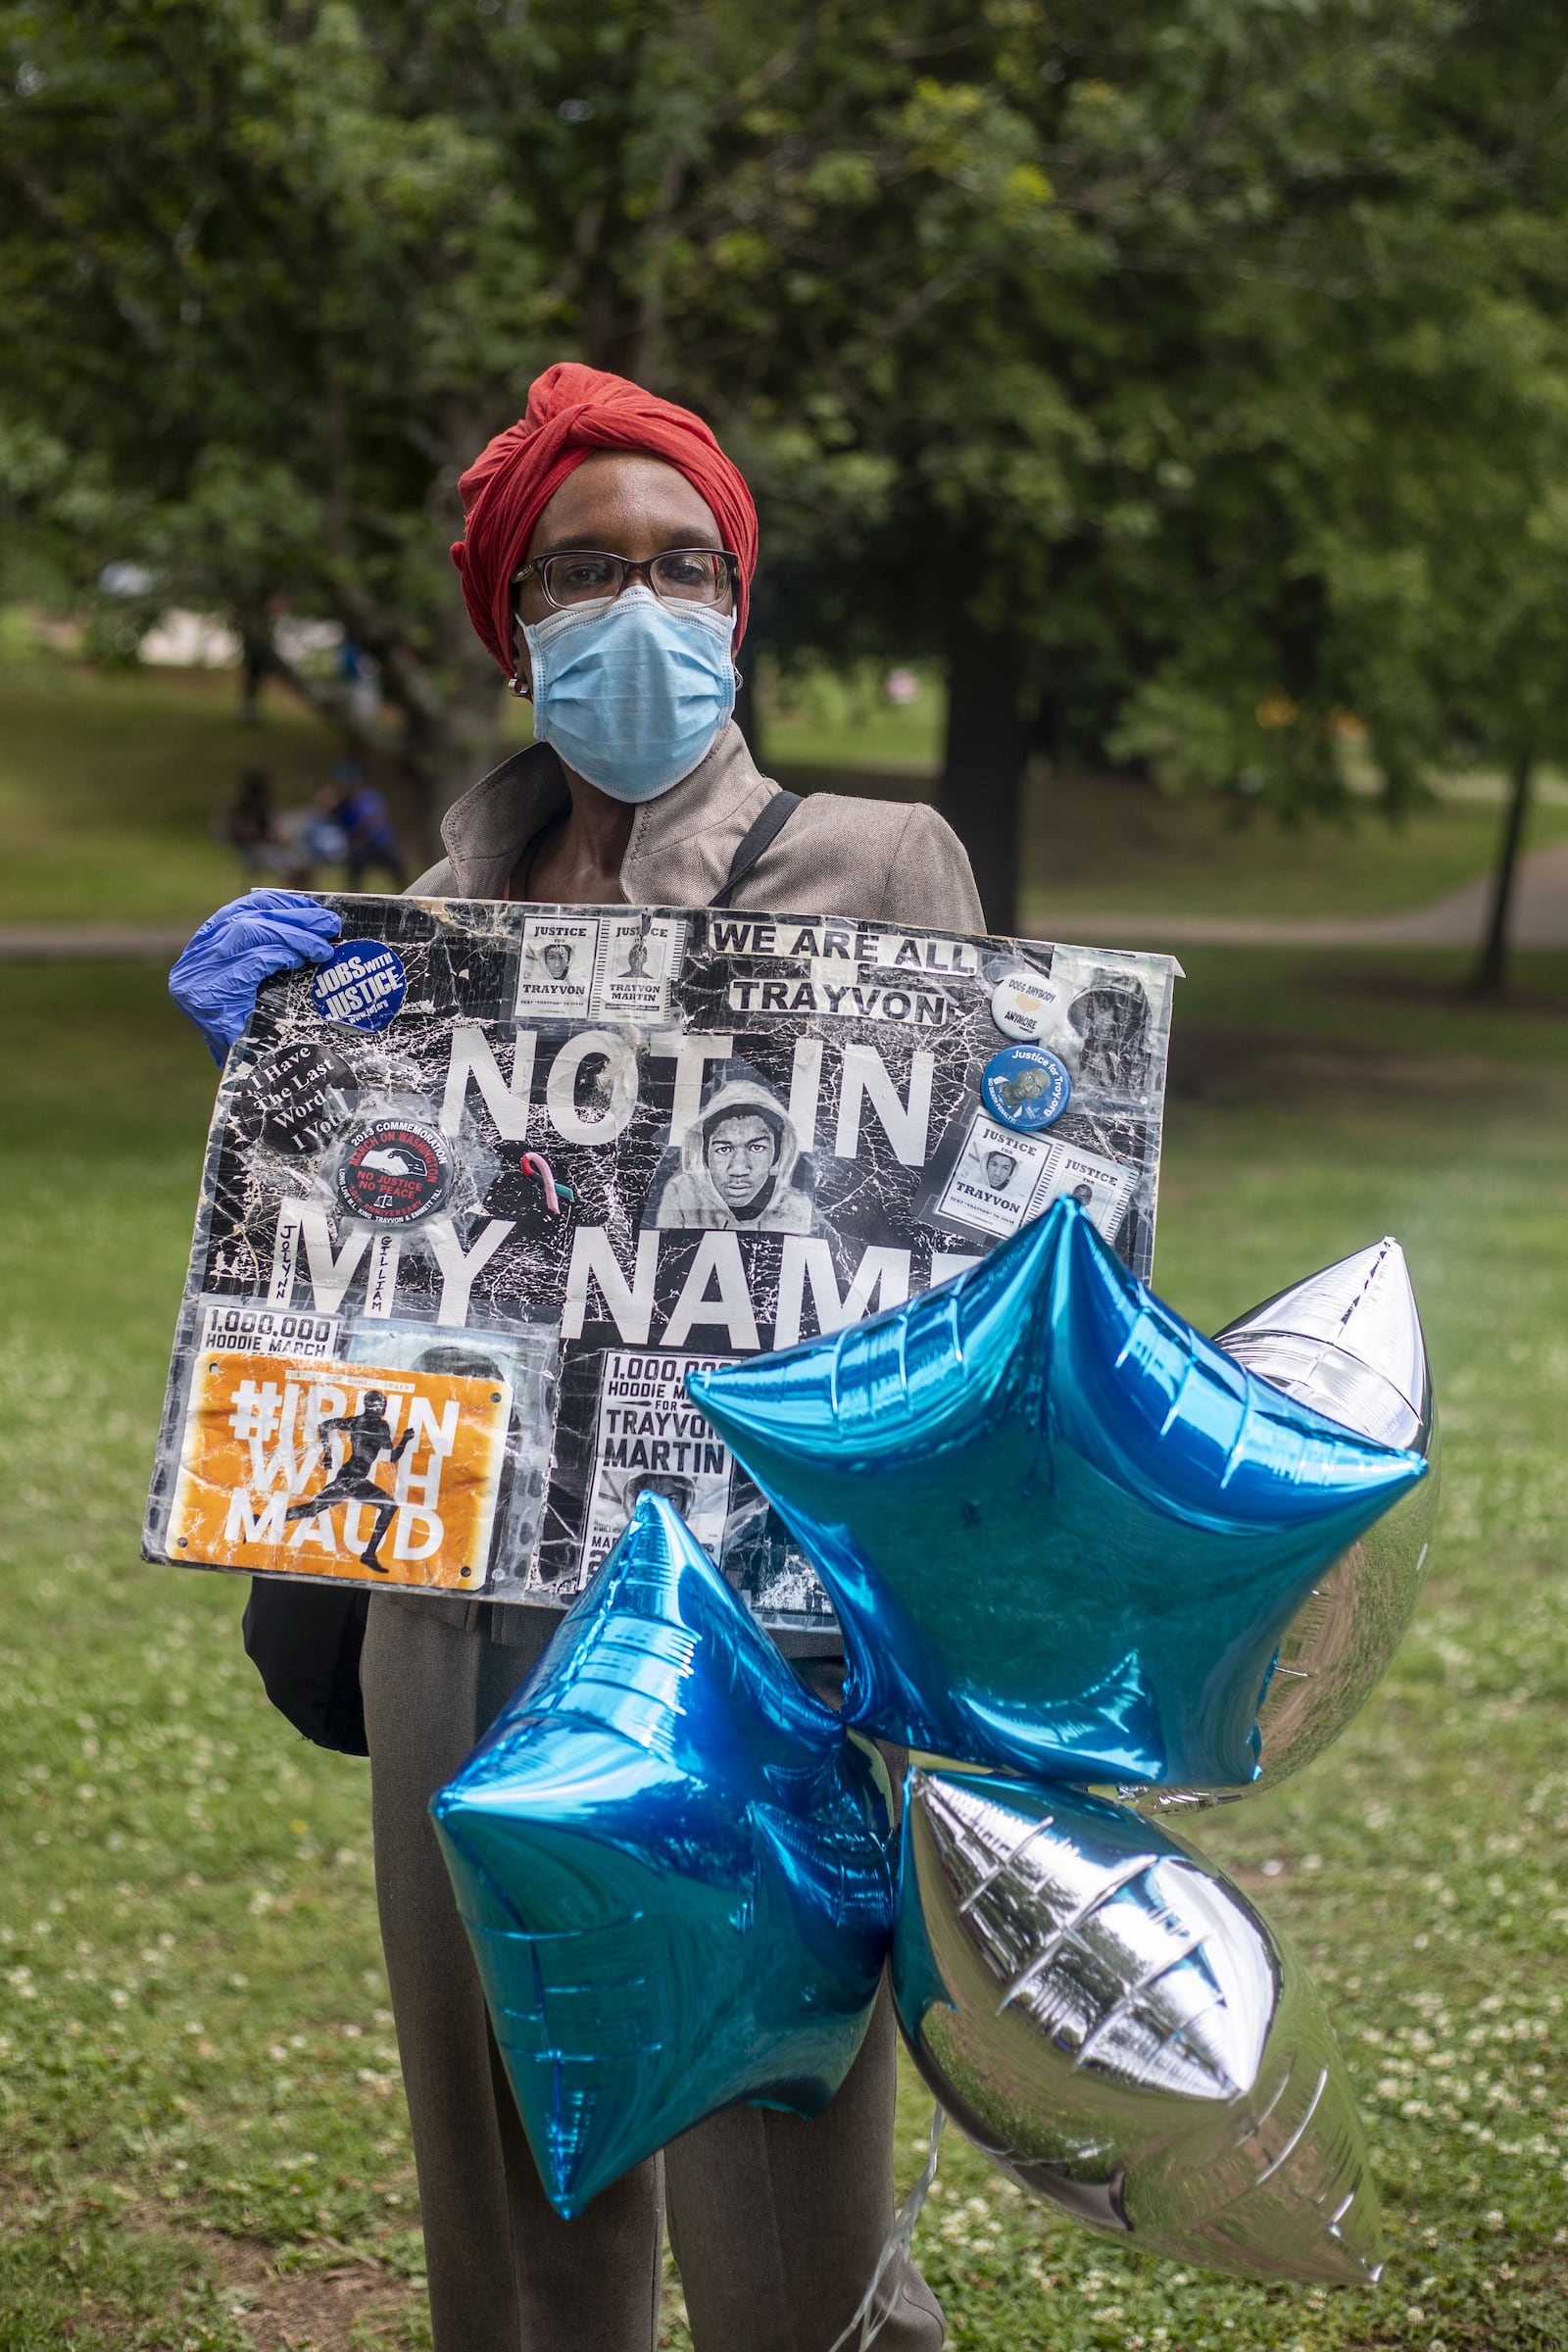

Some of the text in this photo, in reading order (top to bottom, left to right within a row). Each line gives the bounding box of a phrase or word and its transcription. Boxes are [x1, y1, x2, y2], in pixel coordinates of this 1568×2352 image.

[534, 926, 587, 937] JUSTICE
[615, 927, 668, 938] JUSCE
[713, 922, 975, 973] WE ARE ALL
[315, 953, 393, 998] JOBS WITH
[610, 984, 661, 993] TRAYVON
[325, 965, 403, 1020] JUSTICE
[522, 984, 586, 996] TRAYVON
[612, 993, 656, 1002] MARTIN
[733, 982, 944, 1025] TRAYVON
[1008, 979, 1056, 1003] DOES ANYBODY
[1004, 1011, 1037, 1029] ANYMORE
[250, 1047, 311, 1090] I Have
[1011, 1051, 1049, 1066] Justice
[1048, 1063, 1059, 1076] for
[254, 1058, 334, 1110] The Last
[439, 1027, 935, 1167] NOT IN
[1043, 1076, 1063, 1117] Troy.org
[291, 1134, 306, 1151] I
[351, 1122, 448, 1164] 2013 COMMEMORATION
[982, 1128, 1037, 1156] JUSTICE
[350, 1131, 439, 1184] MARCH ON WASHINGTON
[357, 1170, 422, 1192] NO JUSTICE
[1064, 1159, 1118, 1187] JUSTICE
[359, 1181, 416, 1200] NO PEACE
[956, 1181, 1021, 1214] TRAYVON
[358, 1207, 372, 1219] KING
[374, 1215, 404, 1224] TRAYVON
[412, 1200, 434, 1218] EMMETT
[431, 1188, 442, 1201] TILL
[363, 1200, 422, 1216] ANNIVERSARY
[266, 1198, 985, 1350] MY NAM
[371, 1236, 392, 1312] GILLIAM
[206, 1334, 326, 1357] HOODIE MARCH
[608, 1381, 666, 1397] HOODIE
[655, 1400, 677, 1410] FOR
[603, 1438, 724, 1474] MARTIN
[223, 1487, 445, 1560] MAUD
